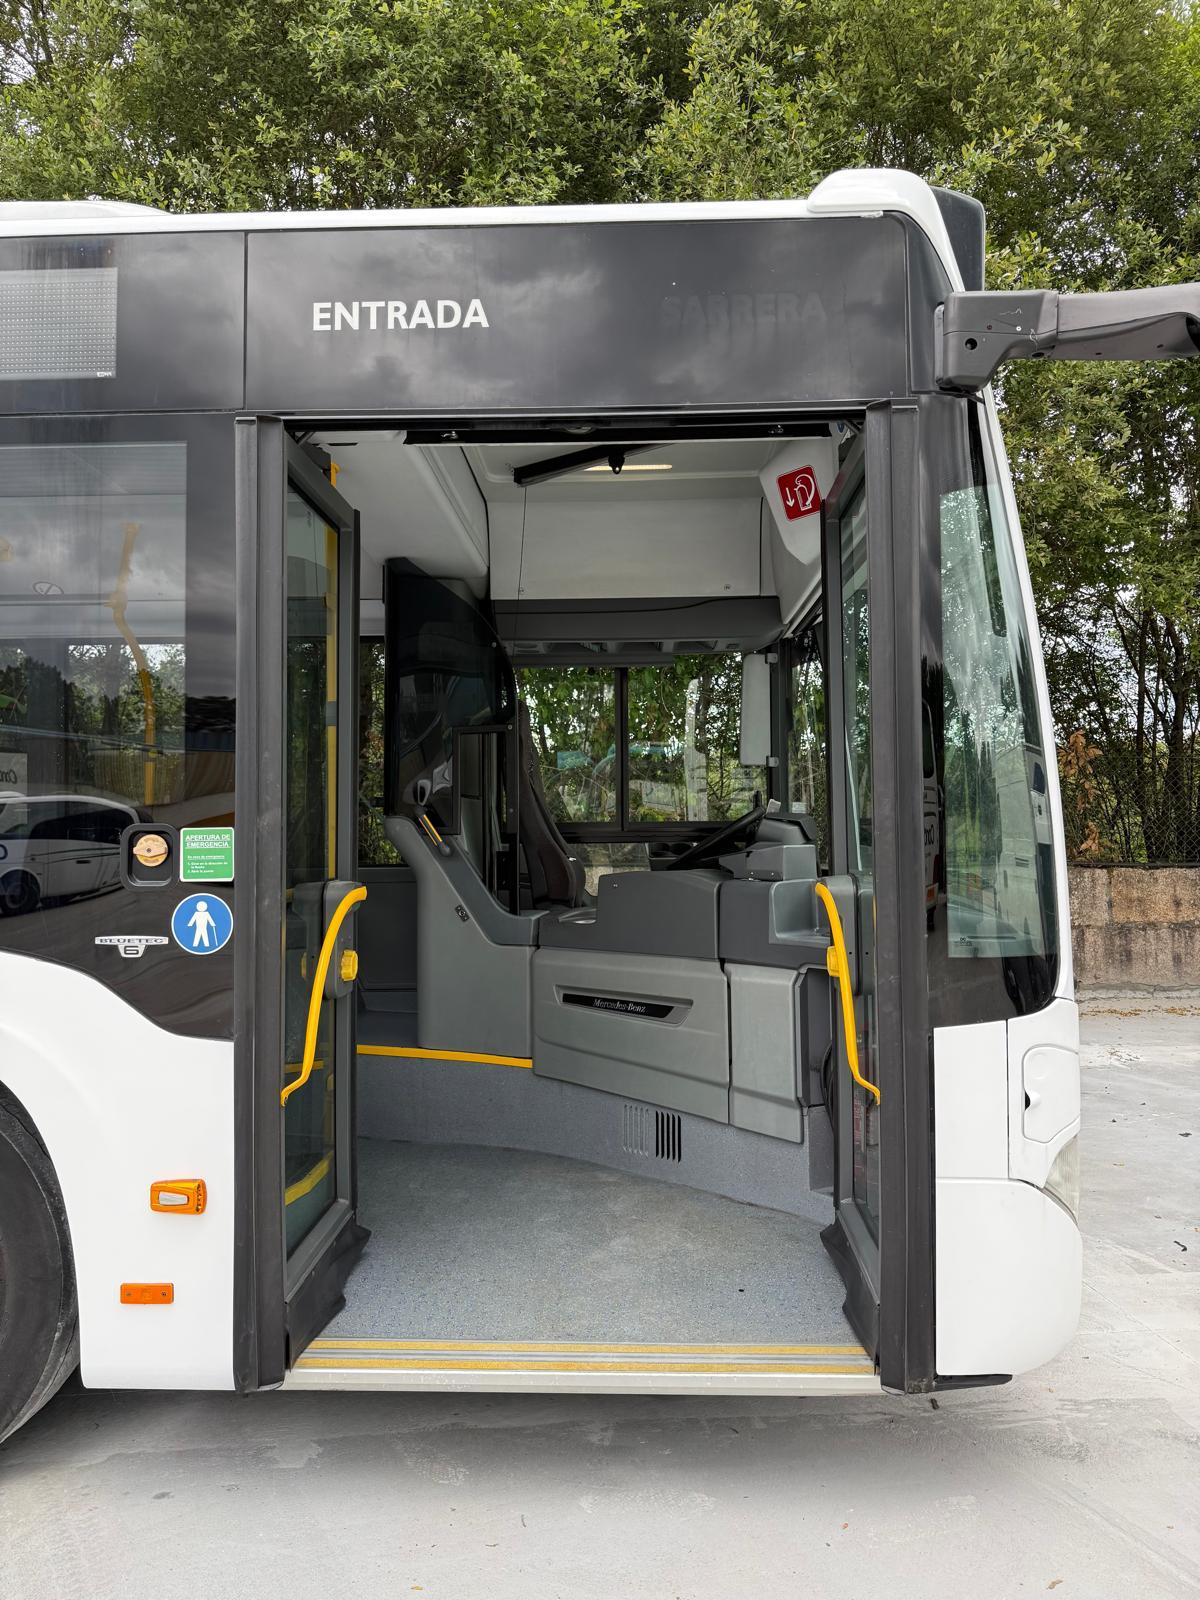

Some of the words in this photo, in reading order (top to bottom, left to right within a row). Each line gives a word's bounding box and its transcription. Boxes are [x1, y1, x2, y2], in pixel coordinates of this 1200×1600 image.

[312, 298, 490, 331] ENTRADA
[221, 833, 231, 841] DE
[99, 937, 164, 945] BLUETEC
[124, 945, 139, 956] 6
